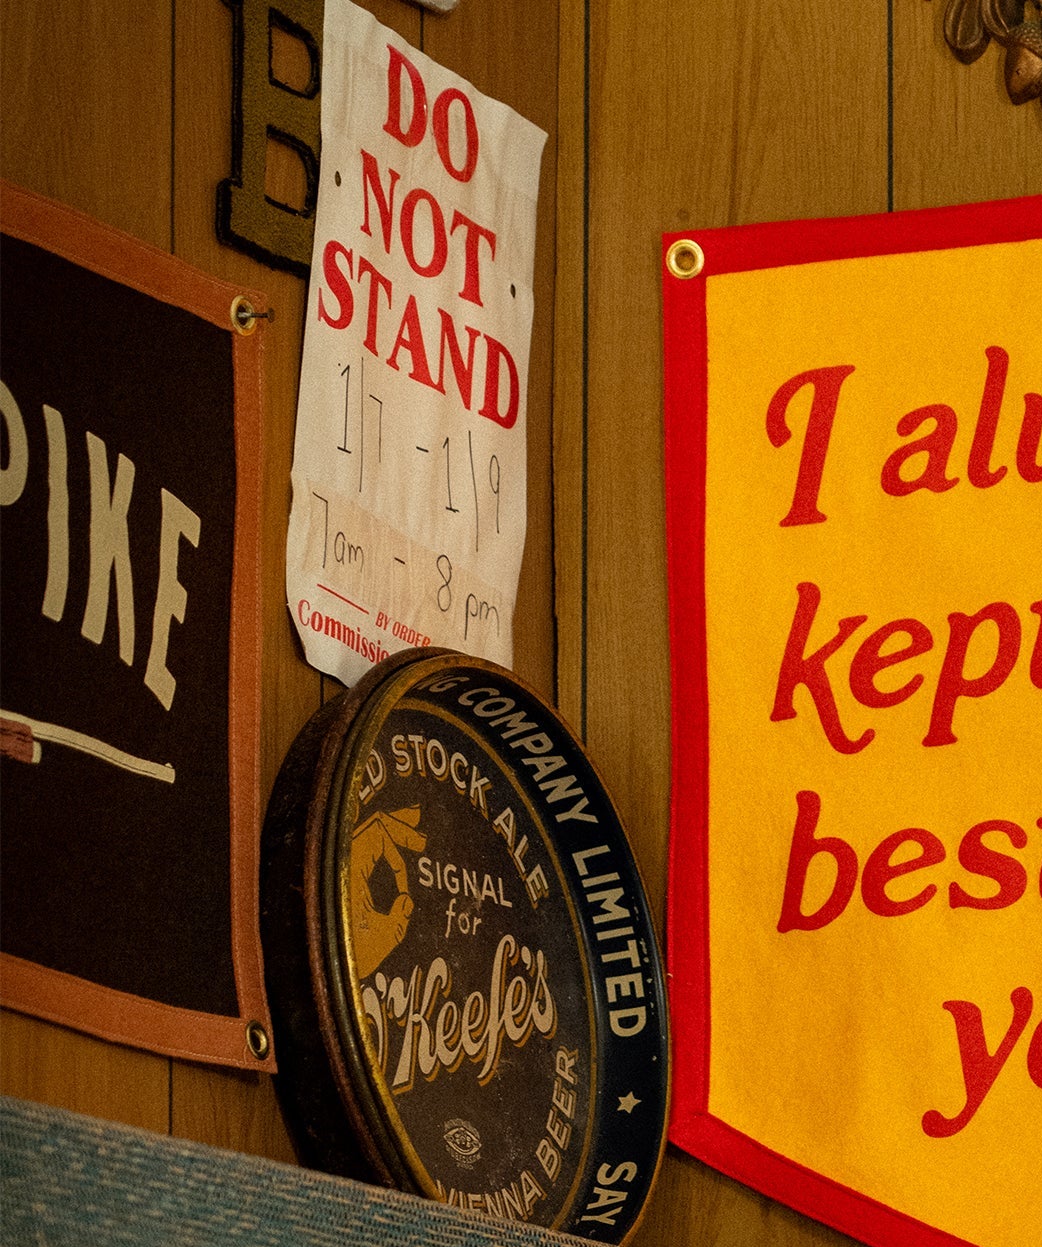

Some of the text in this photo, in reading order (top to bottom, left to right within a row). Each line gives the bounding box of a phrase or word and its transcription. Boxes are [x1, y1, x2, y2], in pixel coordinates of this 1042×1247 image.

[382, 44, 479, 183] DO
[360, 148, 497, 307] NOT
[317, 240, 520, 430] STAND
[765, 364, 856, 528] I
[375, 611, 432, 648] BY ORDER
[391, 733, 491, 818] STOCK
[493, 807, 549, 908] ALE
[417, 856, 513, 908] SIGNAL
[457, 686, 599, 824] COMPANY
[572, 843, 648, 1037] LIMITED
[445, 899, 482, 938] for
[536, 1046, 579, 1184] BEER
[581, 1161, 638, 1227] SAY
